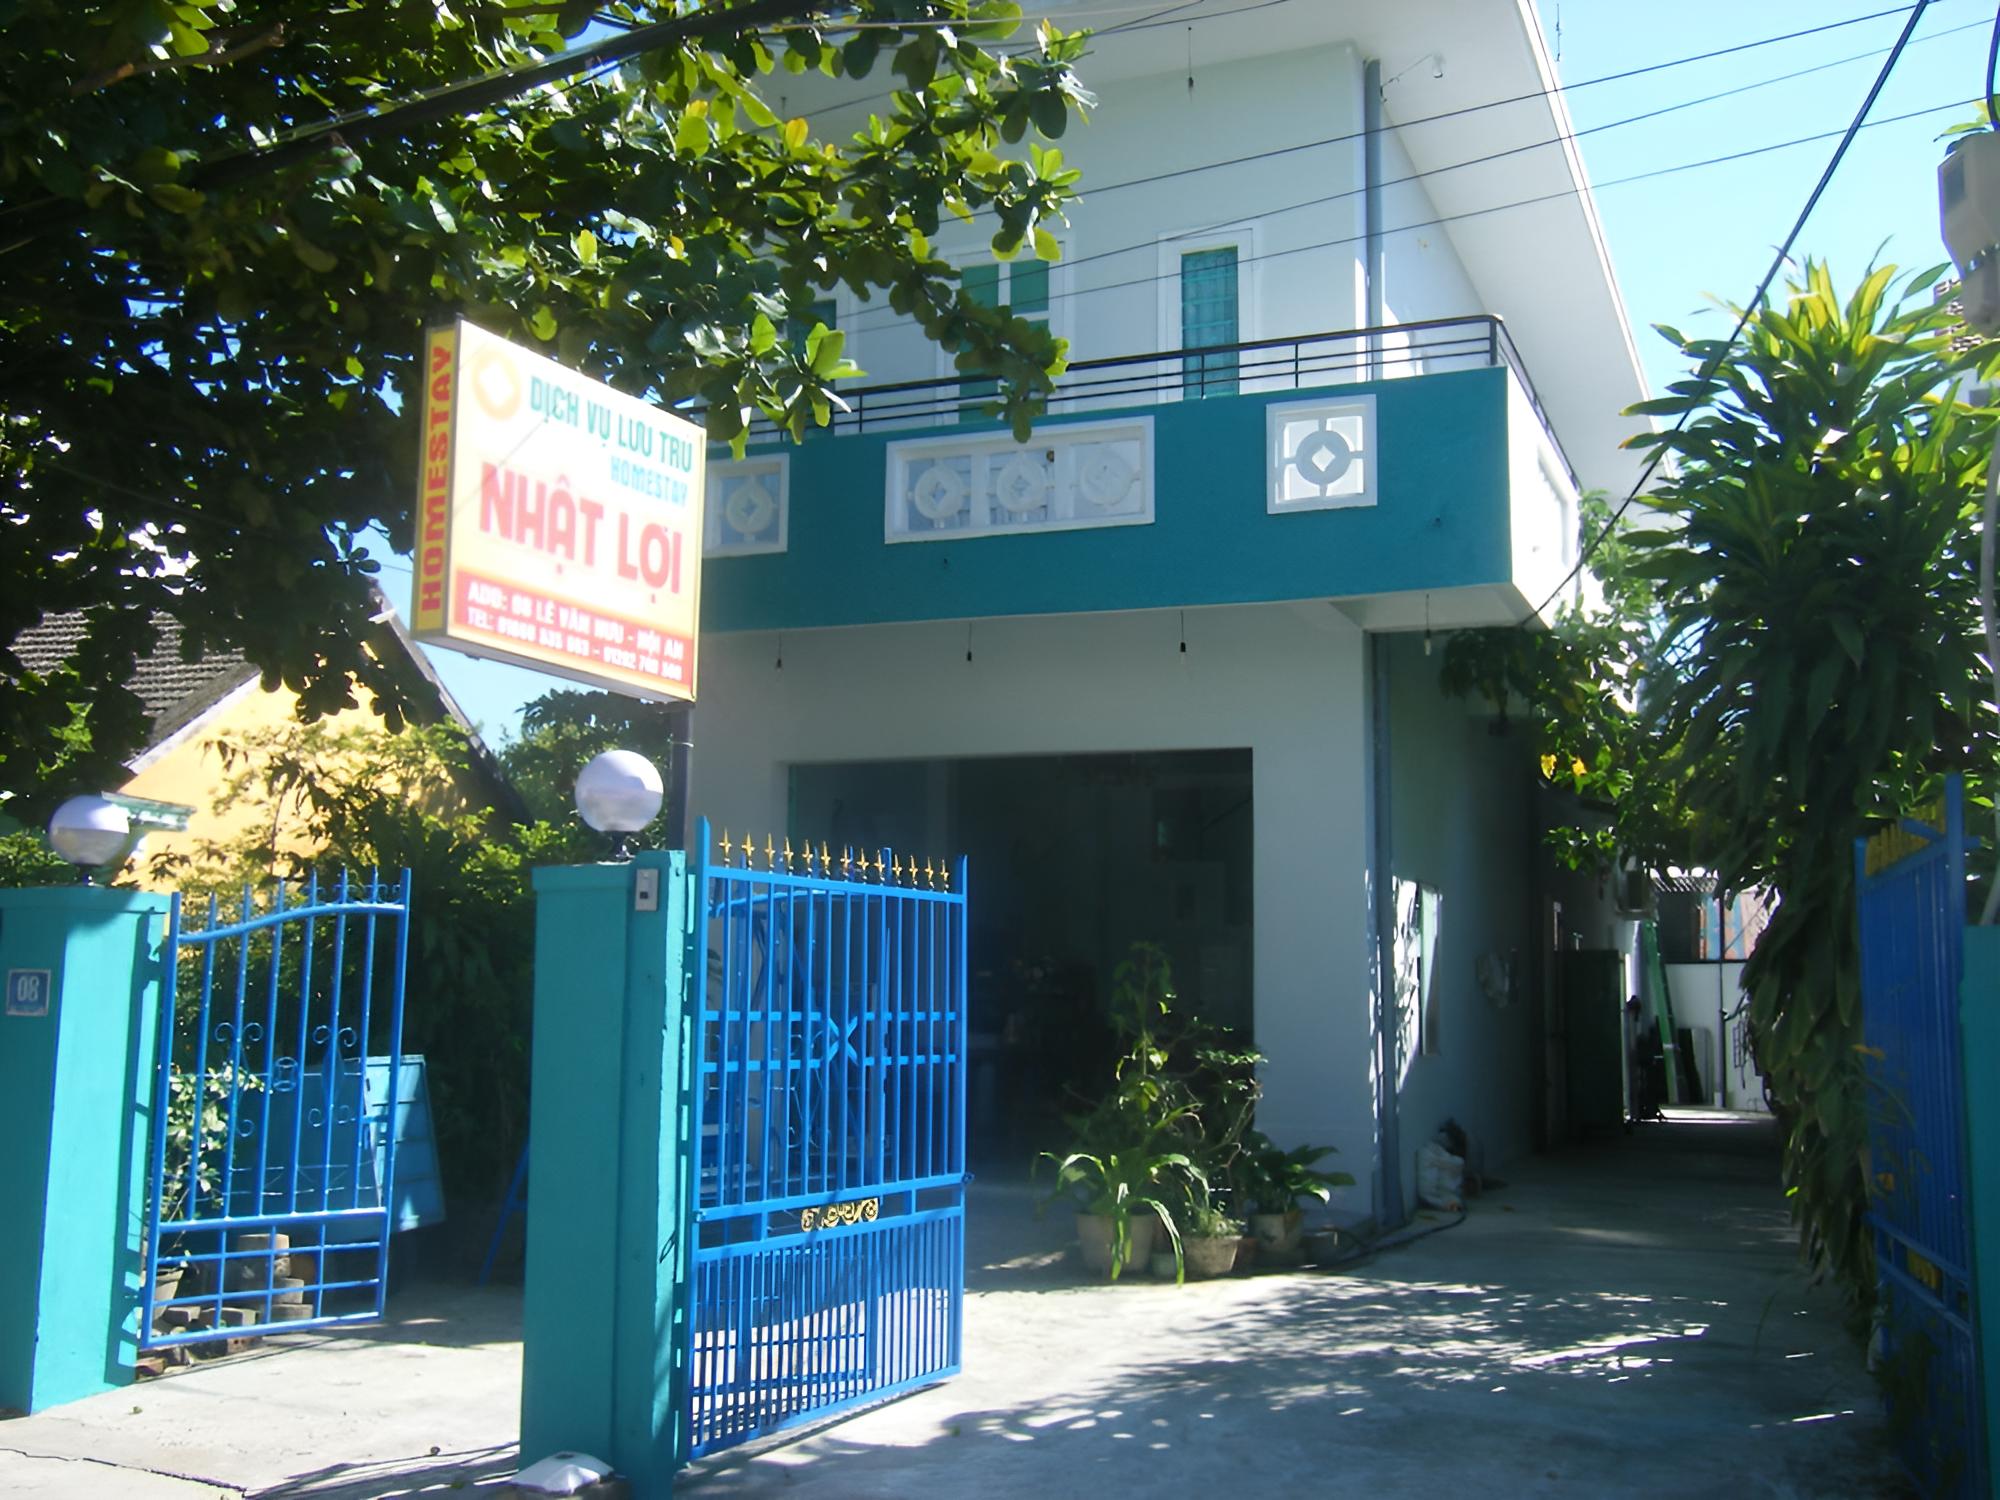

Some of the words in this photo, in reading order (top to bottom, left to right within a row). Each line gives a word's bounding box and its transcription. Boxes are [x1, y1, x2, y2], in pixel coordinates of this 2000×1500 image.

[530, 375, 579, 427] DỊCH
[587, 400, 611, 447] VỤ
[421, 345, 453, 612] HOMESTAY
[610, 455, 688, 507] HOMESTAY
[479, 461, 604, 575] NHẬT
[535, 597, 554, 625] LÊ
[16, 975, 40, 1001] 08
